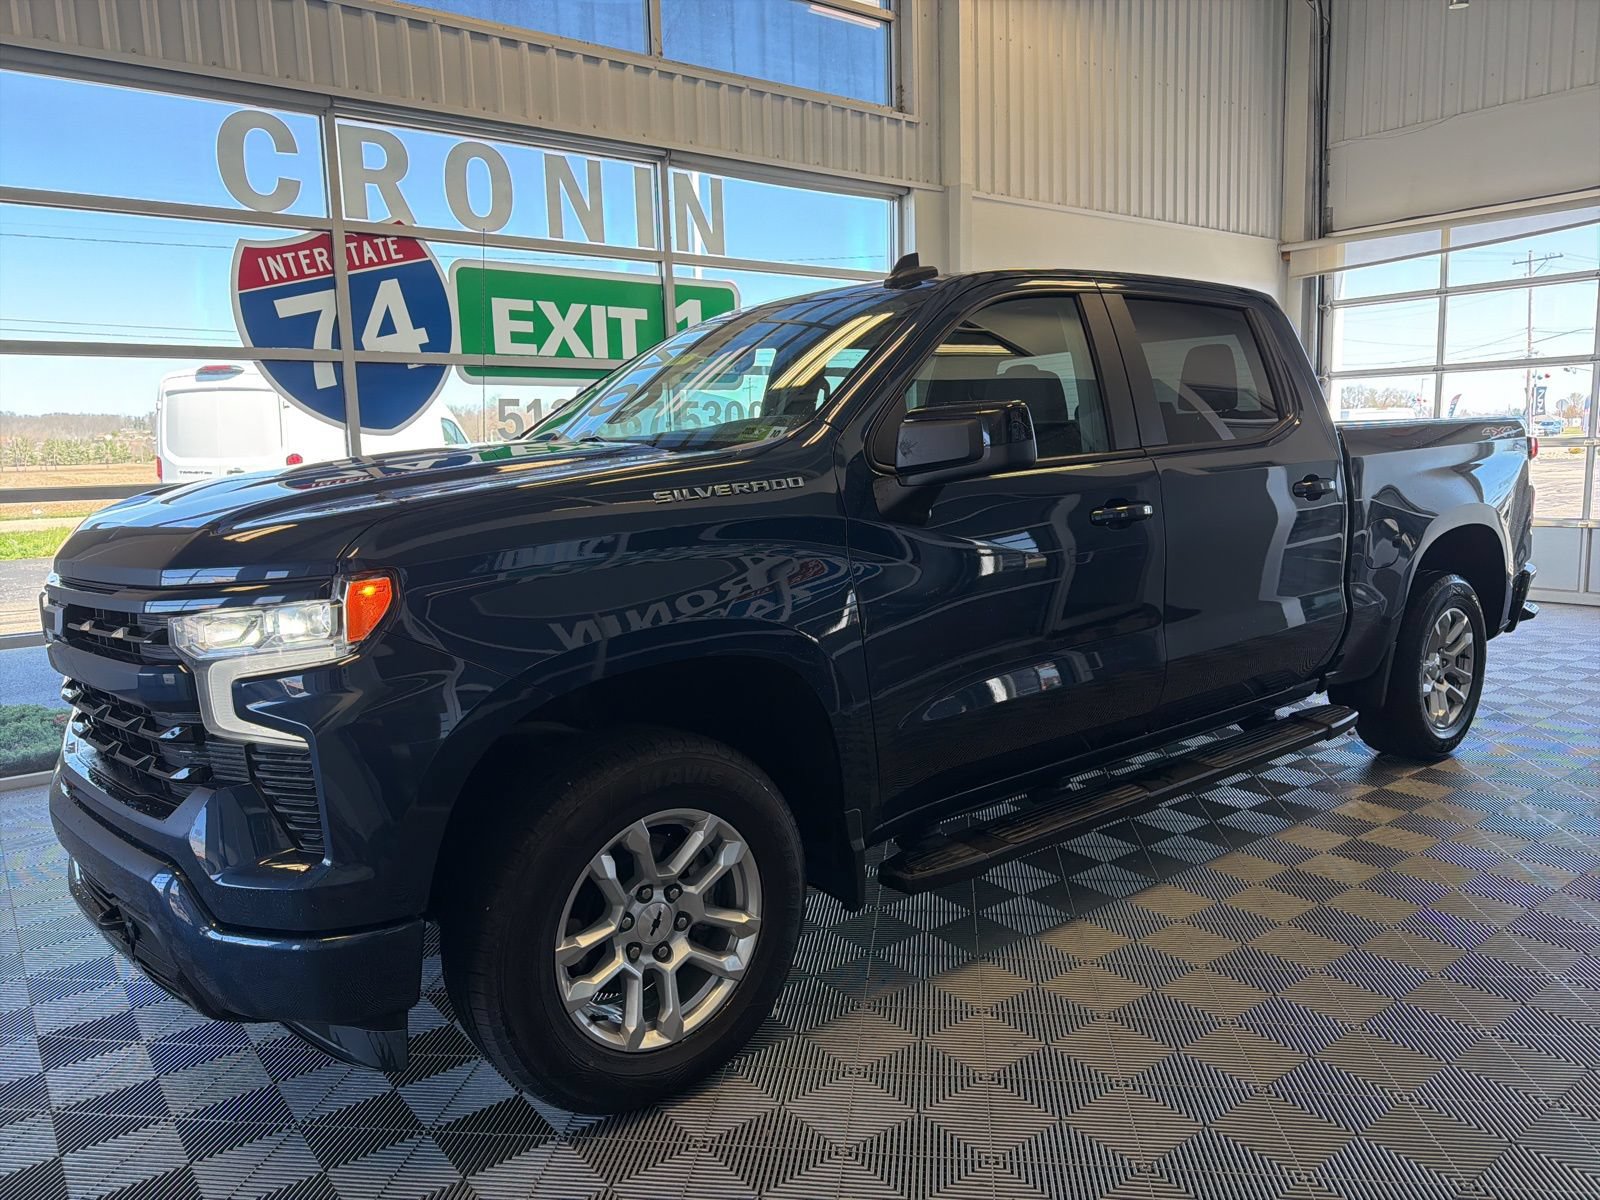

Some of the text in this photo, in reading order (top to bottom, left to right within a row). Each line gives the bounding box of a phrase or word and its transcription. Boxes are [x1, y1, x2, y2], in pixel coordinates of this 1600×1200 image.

[216, 110, 726, 256] CRONIN
[257, 236, 404, 282] INTERTATE
[273, 278, 430, 390] 74
[491, 297, 648, 360] EXIT
[652, 476, 805, 504] SILVERADO
